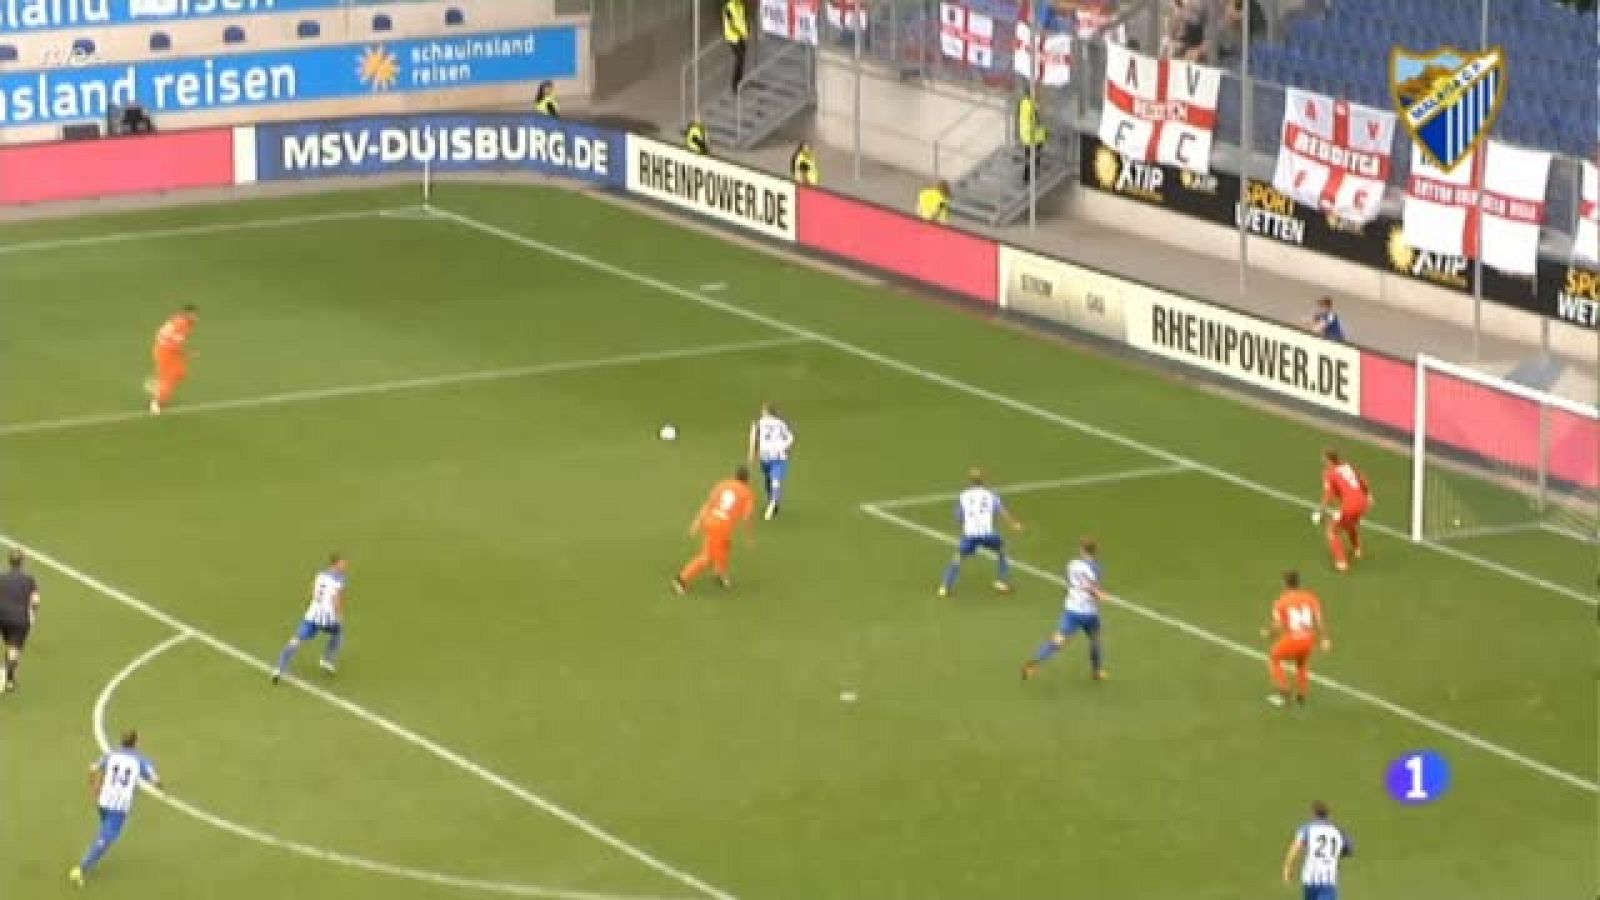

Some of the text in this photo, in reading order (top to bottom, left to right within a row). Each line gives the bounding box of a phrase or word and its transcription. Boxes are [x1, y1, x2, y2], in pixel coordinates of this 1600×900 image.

[411, 34, 535, 64] schauinsland
[0, 59, 296, 121] sland reisen
[412, 64, 471, 85] reisen
[1126, 57, 1201, 96] A V
[282, 126, 609, 174] MSV-DUISBURG.DE
[638, 150, 790, 231] RHEINPOWER.DE
[1151, 304, 1348, 402] RHEINPOWER.DE
[1314, 834, 1337, 858] 21
